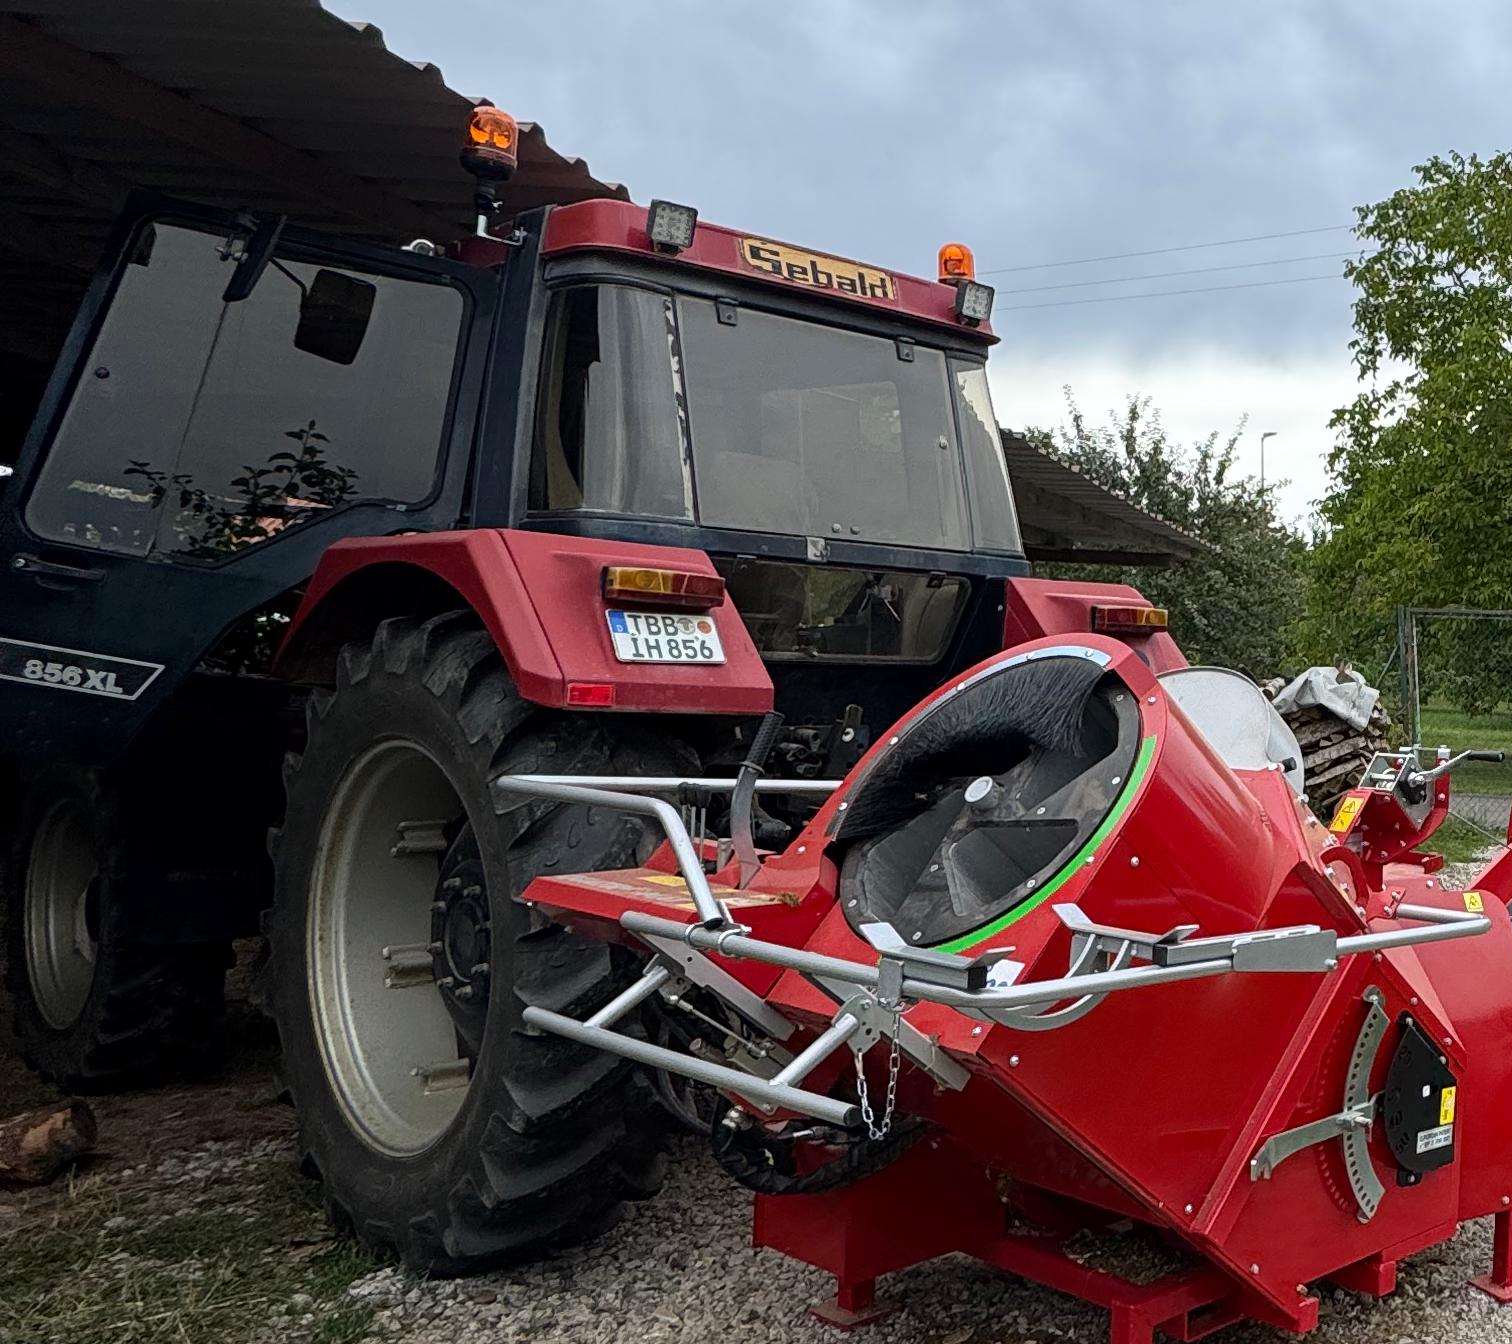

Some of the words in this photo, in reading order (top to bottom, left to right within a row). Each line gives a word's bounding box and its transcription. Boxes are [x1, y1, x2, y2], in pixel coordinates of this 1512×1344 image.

[748, 243, 889, 299] Sebald
[627, 615, 679, 637] TBB
[631, 637, 663, 659] IH
[666, 638, 714, 659] 856
